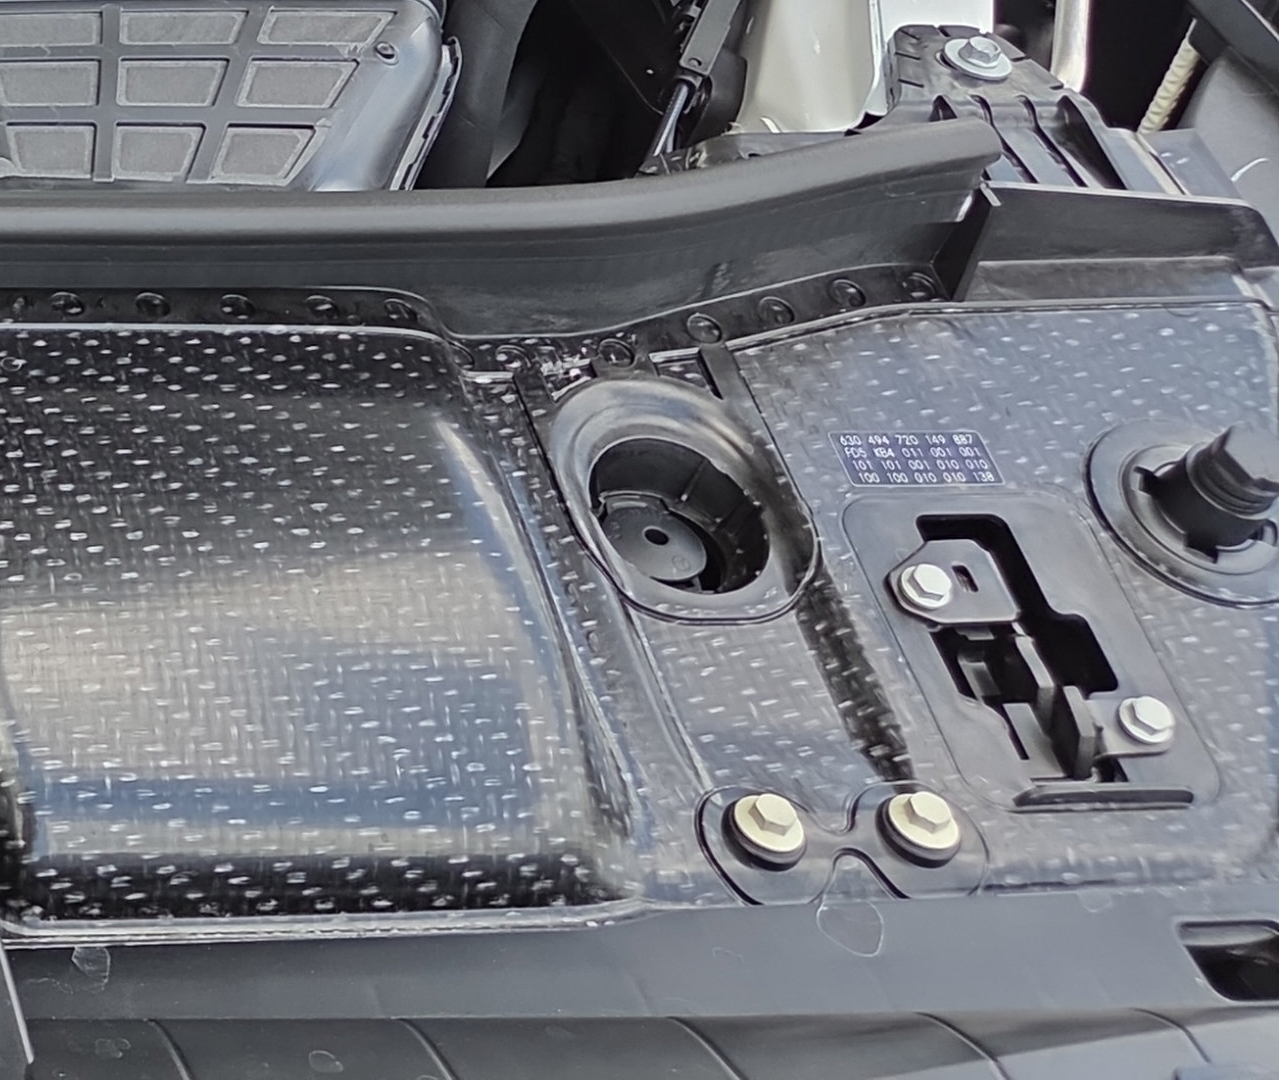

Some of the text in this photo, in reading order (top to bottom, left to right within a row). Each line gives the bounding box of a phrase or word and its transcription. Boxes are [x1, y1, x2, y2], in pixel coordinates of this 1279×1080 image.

[839, 434, 862, 446] 630
[868, 434, 890, 445] 494
[895, 434, 919, 445] 720
[925, 434, 946, 445] 149
[901, 447, 924, 458] 011
[930, 447, 952, 458] 001
[958, 447, 981, 457] 001
[852, 460, 988, 471] 101 101 001 010 010
[858, 472, 995, 483] 100 100 010 010 138
